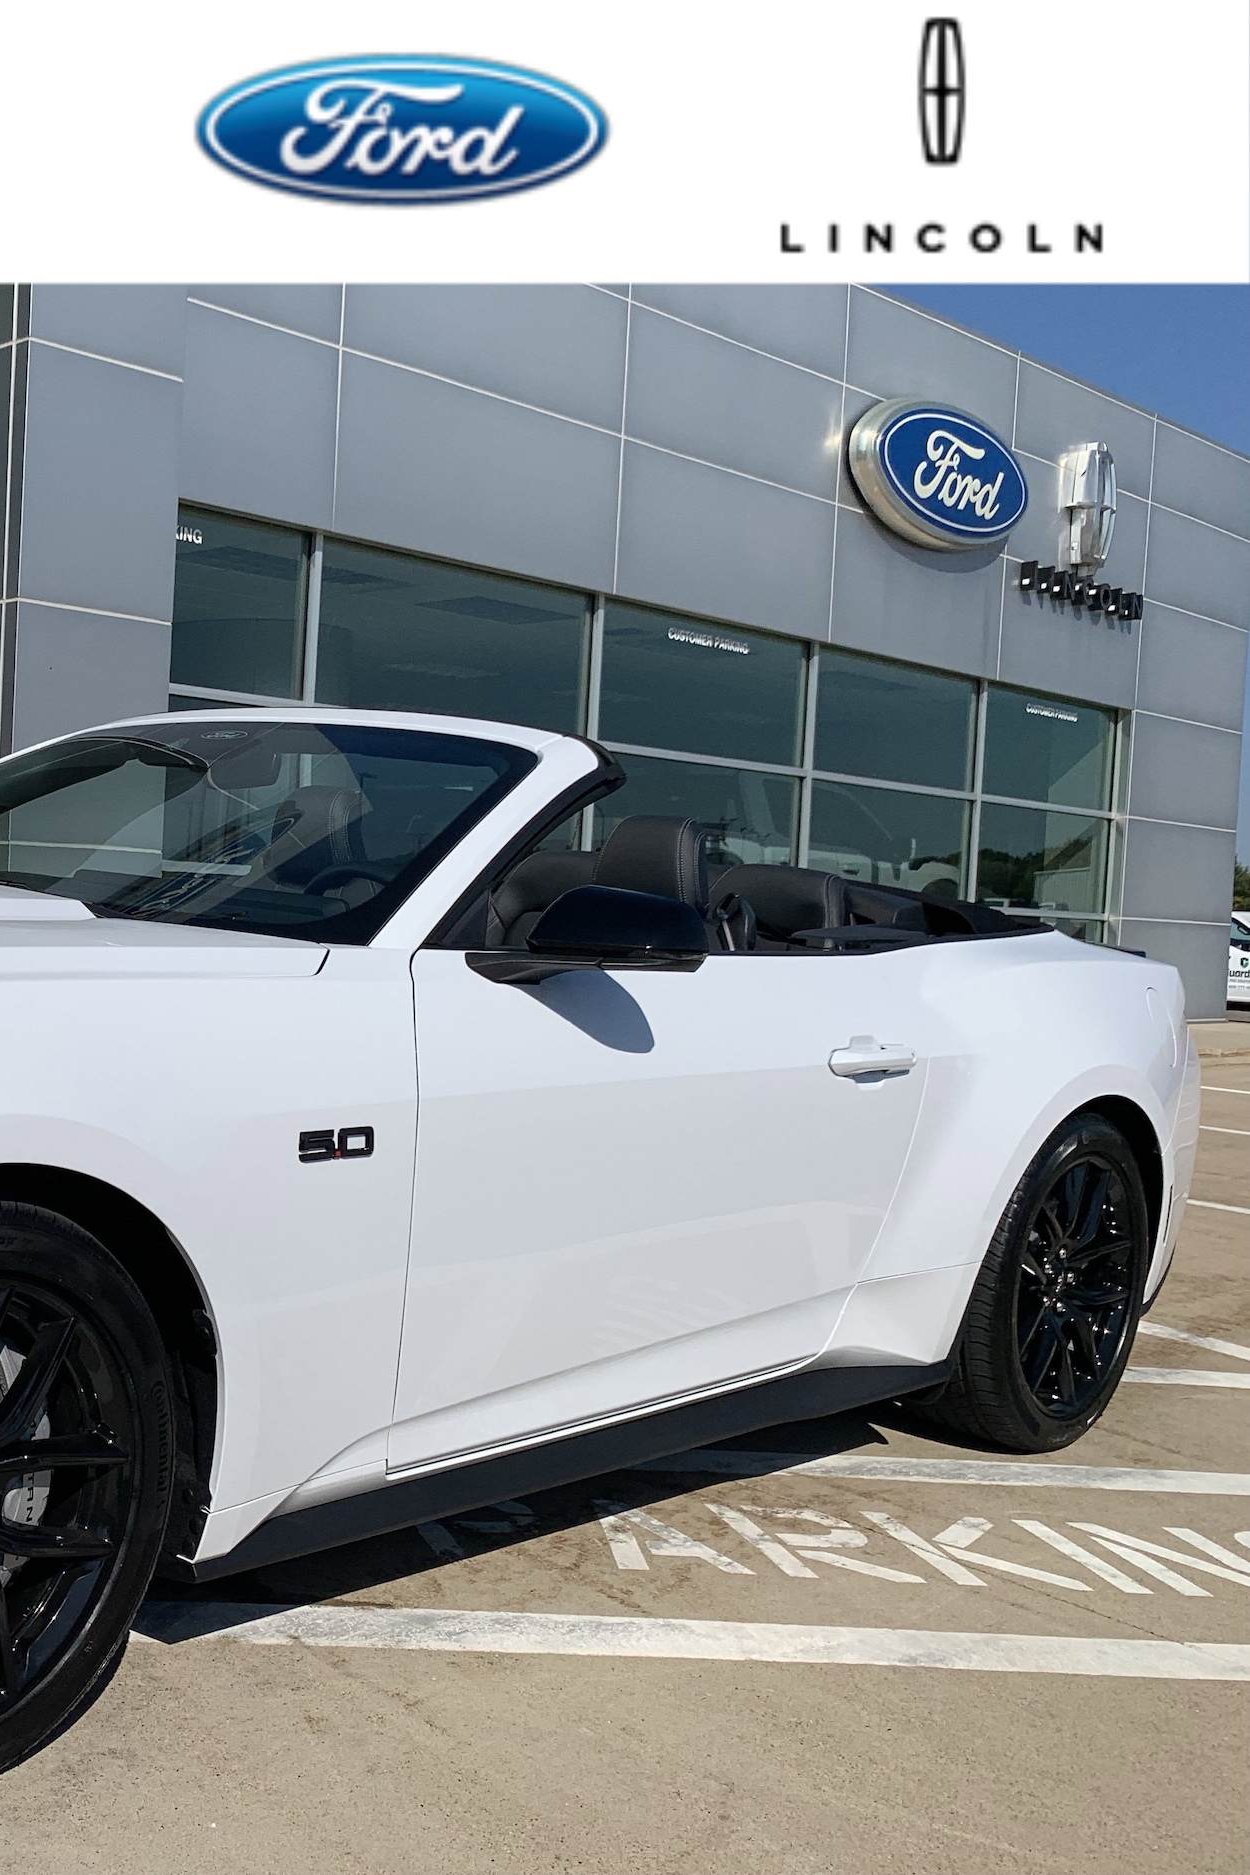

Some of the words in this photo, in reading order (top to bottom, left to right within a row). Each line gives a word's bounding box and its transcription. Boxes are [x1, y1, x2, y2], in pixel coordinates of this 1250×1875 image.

[913, 429, 1005, 521] Ford
[668, 627, 713, 648] CUSTOMER
[714, 635, 750, 655] PARKING
[298, 1126, 375, 1164] 5.0
[414, 1500, 1250, 1598] PARKIN
